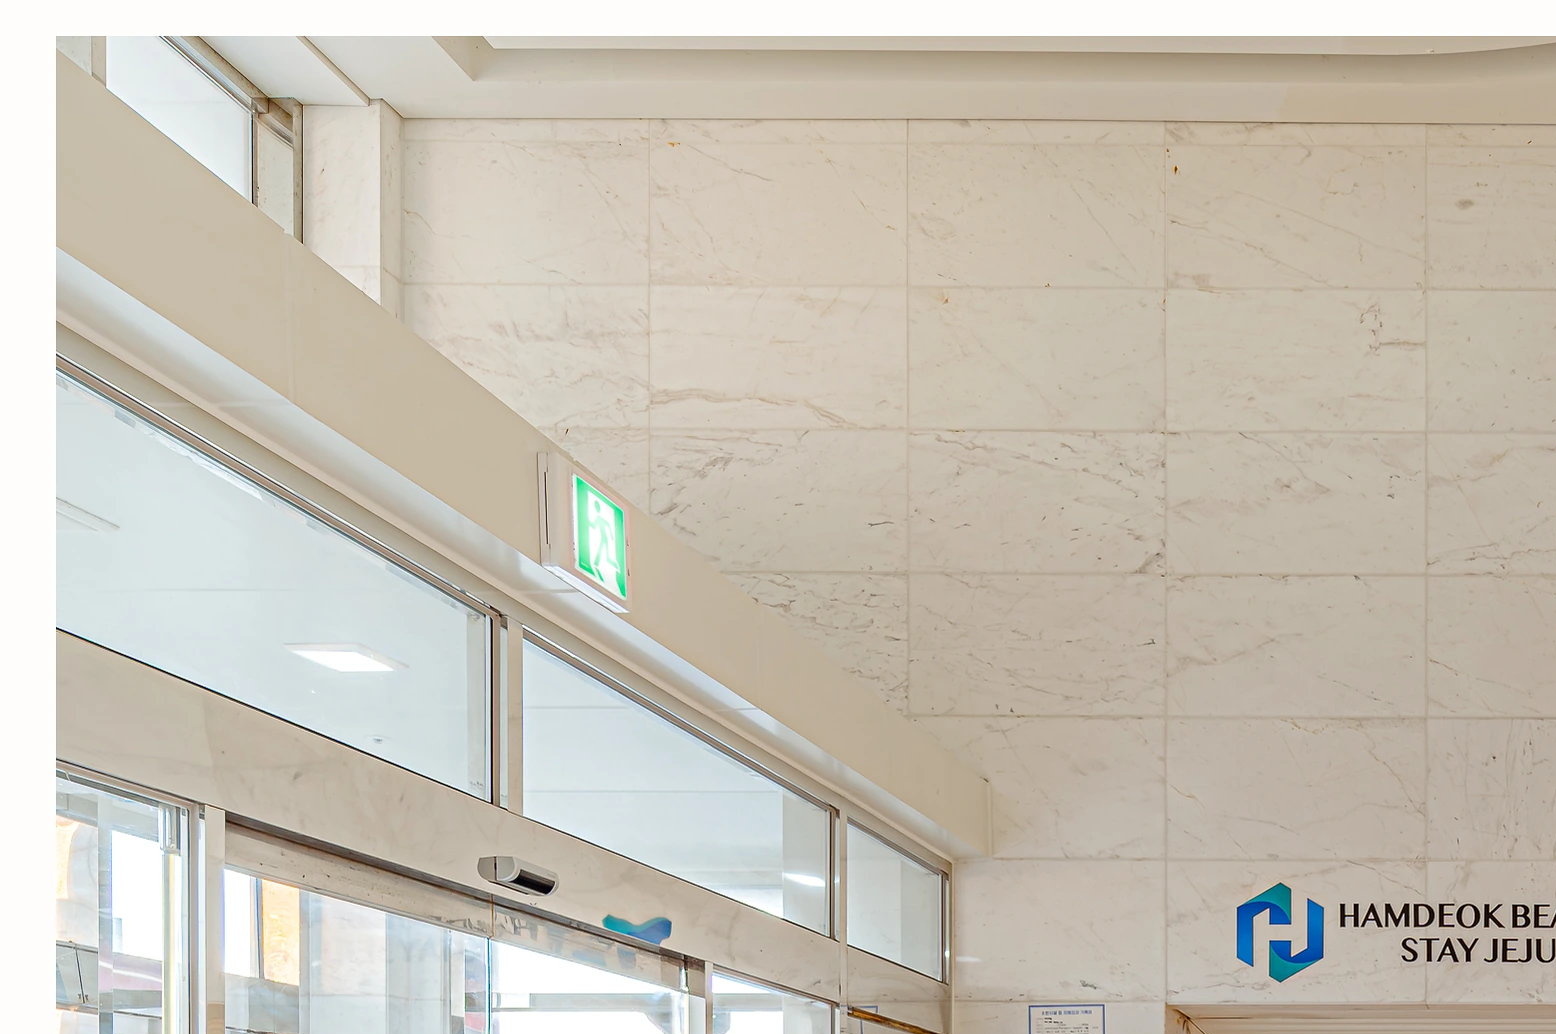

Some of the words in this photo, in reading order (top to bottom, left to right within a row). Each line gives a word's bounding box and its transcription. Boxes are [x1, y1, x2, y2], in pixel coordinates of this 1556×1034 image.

[1339, 903, 1505, 929] HAMDEOK
[1400, 937, 1479, 964] STAY
[1483, 937, 1556, 964] JEJU
